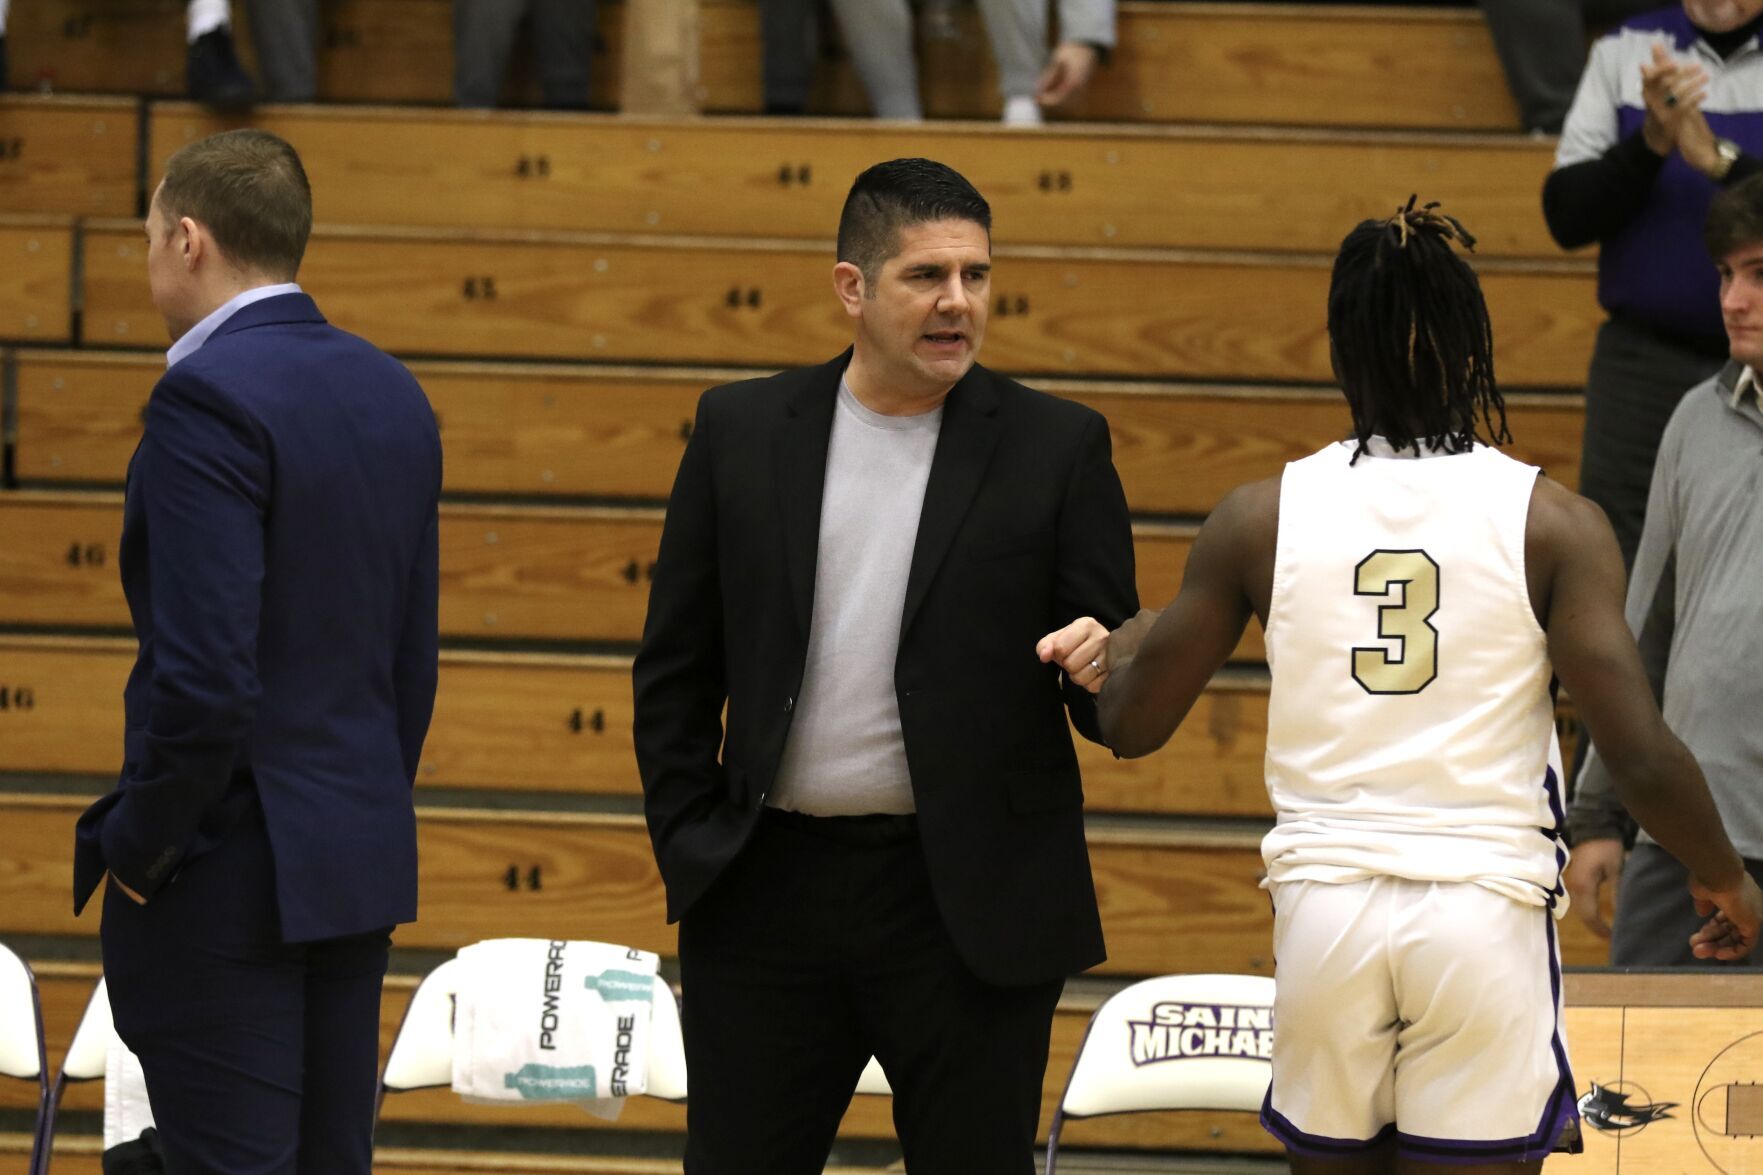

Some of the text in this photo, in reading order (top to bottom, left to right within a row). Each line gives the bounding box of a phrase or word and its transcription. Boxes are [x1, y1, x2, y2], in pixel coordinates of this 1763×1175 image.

[1351, 549, 1440, 695] 3
[566, 706, 605, 734] 44
[501, 864, 543, 892] 44
[1153, 1002, 1274, 1030] SAIN
